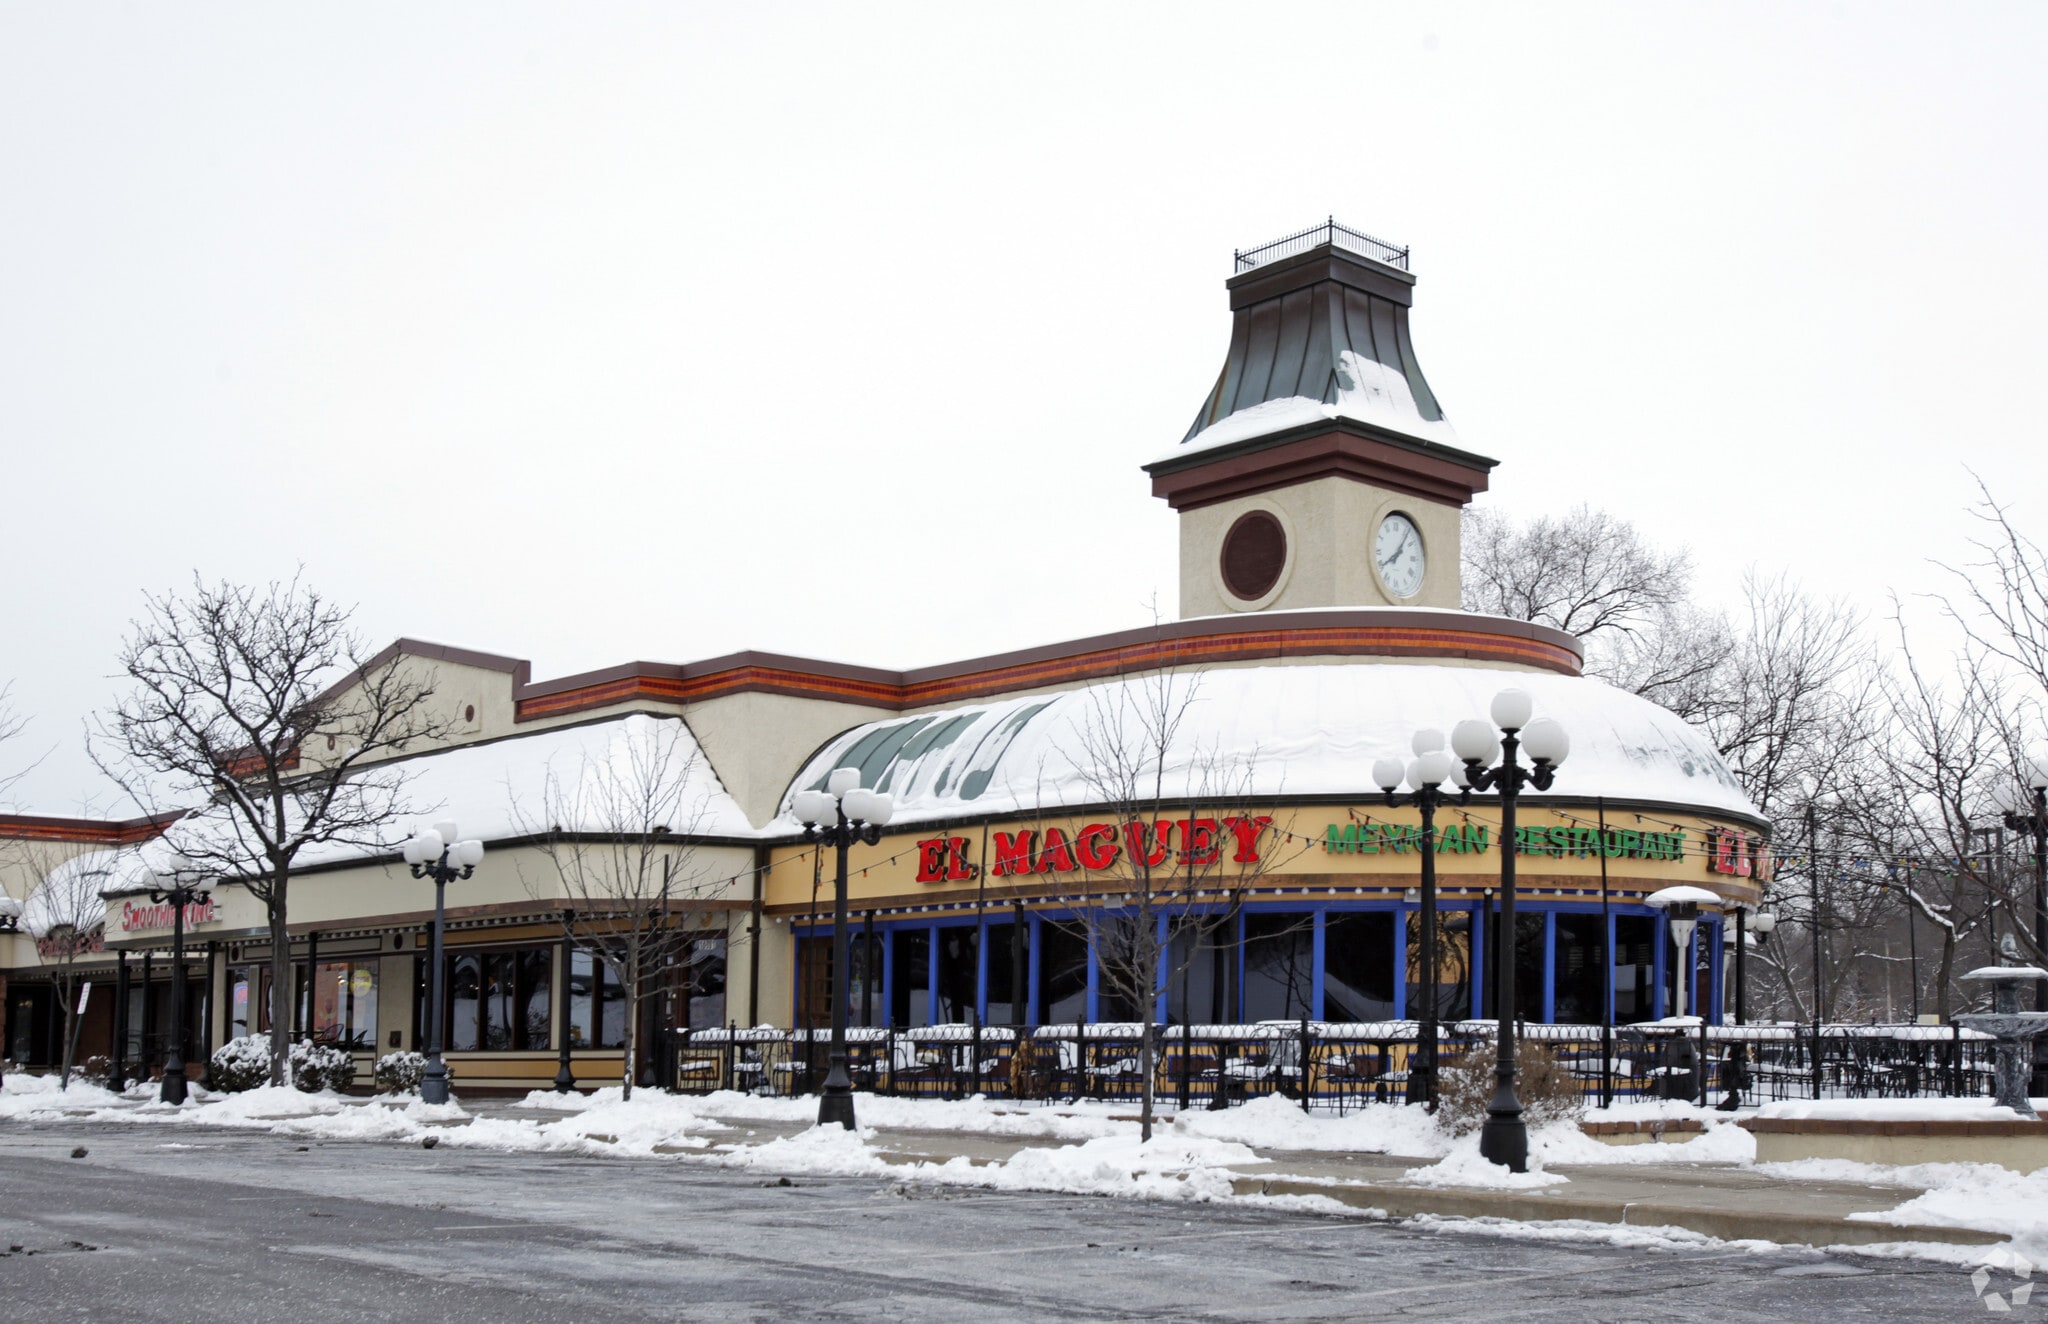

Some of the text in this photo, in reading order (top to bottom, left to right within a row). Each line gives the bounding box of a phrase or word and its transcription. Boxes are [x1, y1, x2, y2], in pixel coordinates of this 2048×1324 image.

[916, 816, 1274, 883] EL MAGUEY
[1327, 824, 1687, 860] MEXICAN RESTAURANT
[1716, 828, 1751, 877] EL
[122, 899, 214, 931] SMOOTHIE KING
